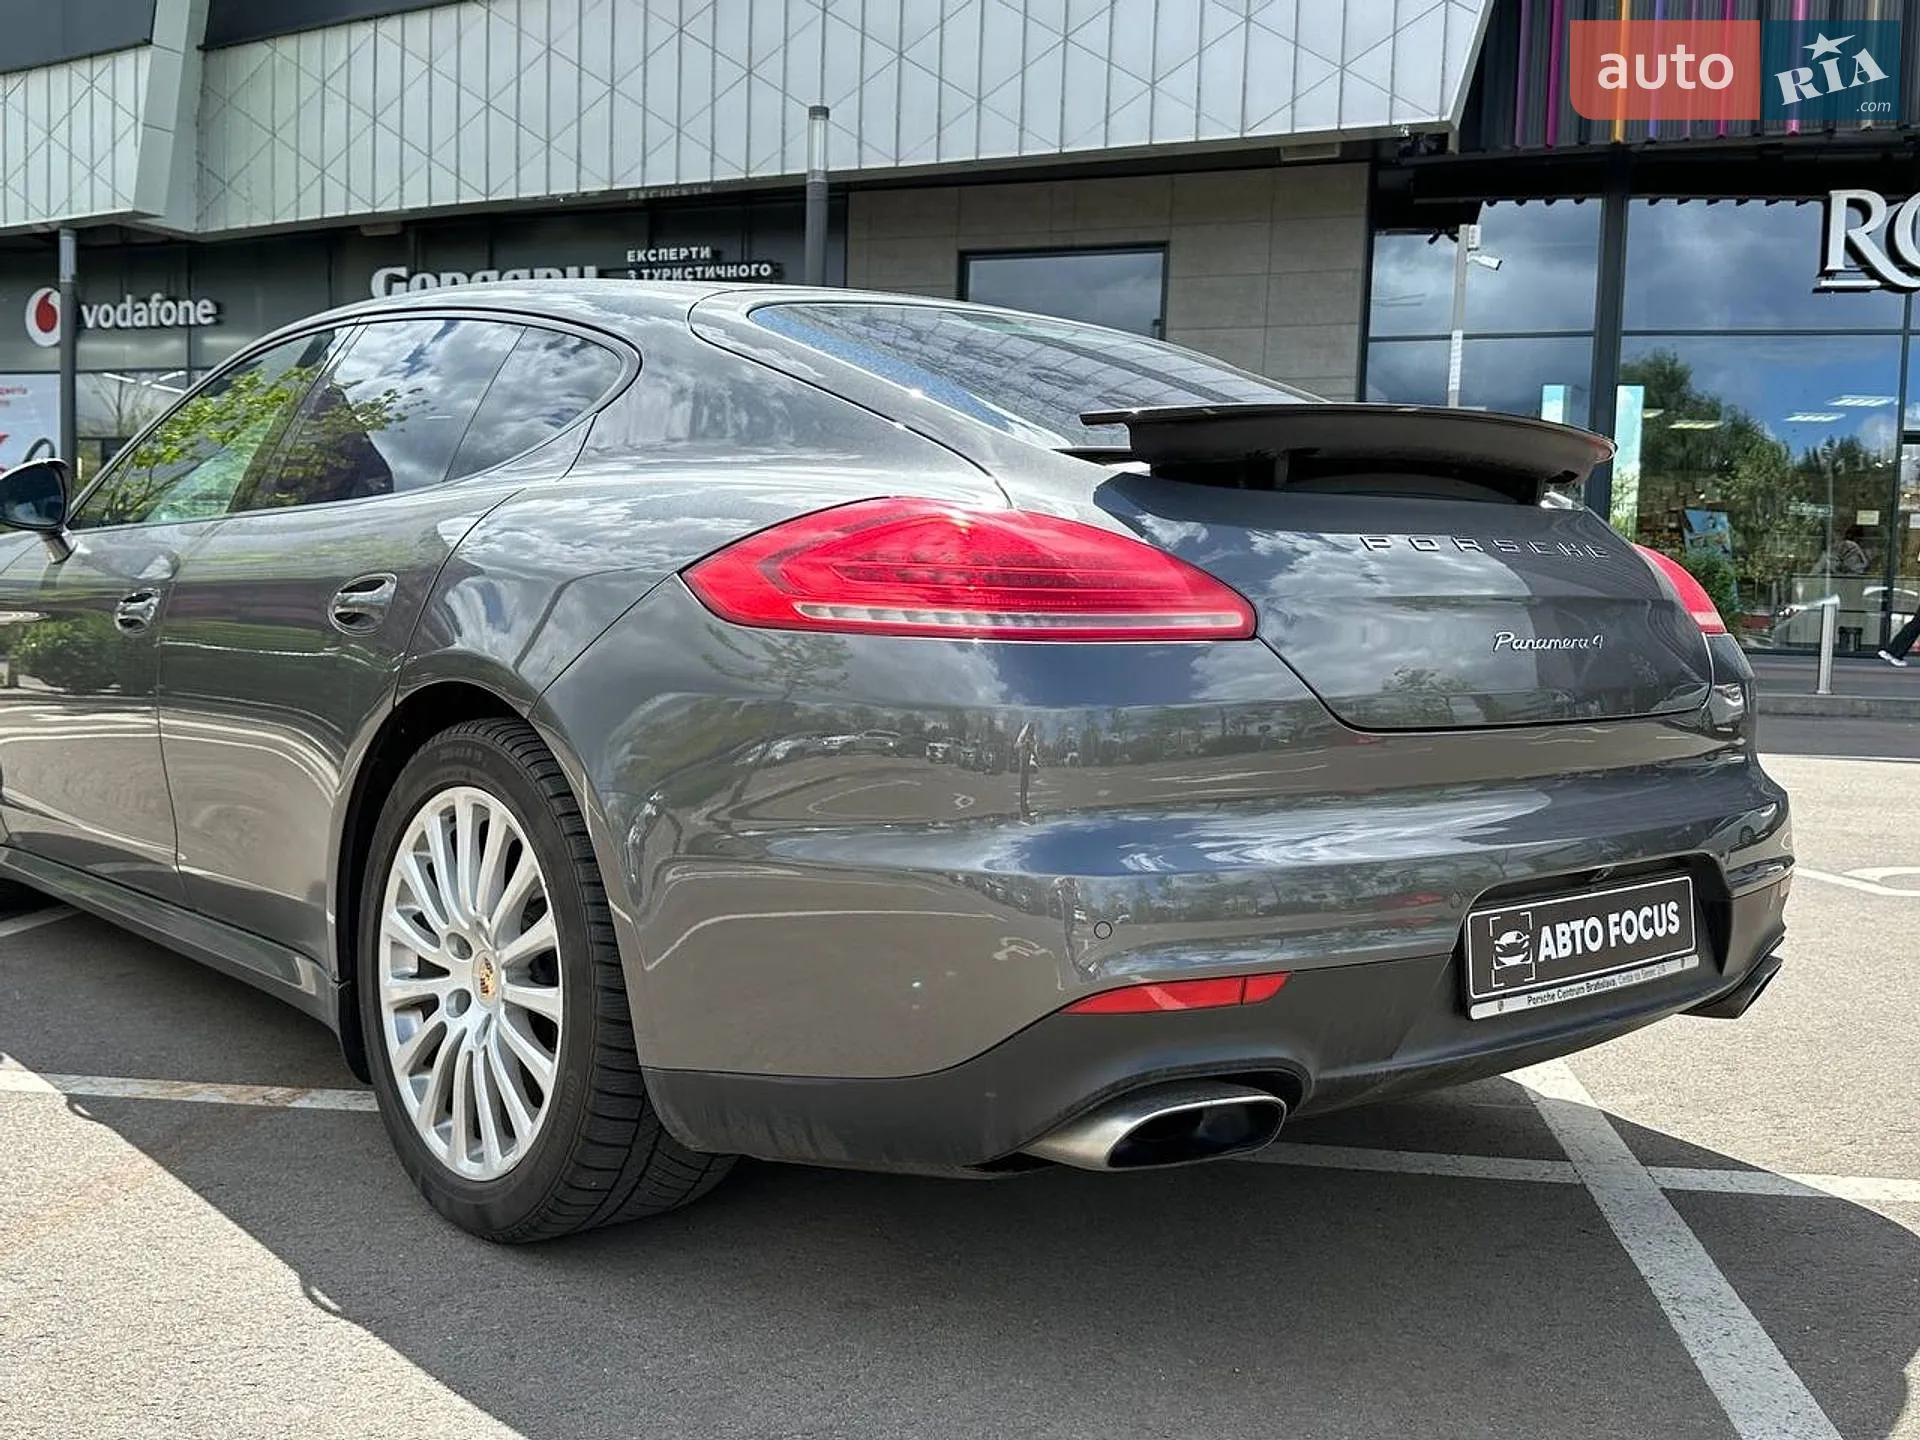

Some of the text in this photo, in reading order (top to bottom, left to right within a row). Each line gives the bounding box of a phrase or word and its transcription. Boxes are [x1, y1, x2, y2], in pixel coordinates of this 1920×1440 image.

[627, 246, 712, 262] ЕКСПЕРТИ
[640, 263, 772, 281] ТУРИСТИЧНОГО
[80, 292, 217, 329] vodafone
[1360, 536, 1608, 560] PORSCHE
[1493, 631, 1589, 651] Panamera
[1538, 901, 1680, 962] АВТО FOCUS
[1527, 990, 1555, 1006] Porsche
